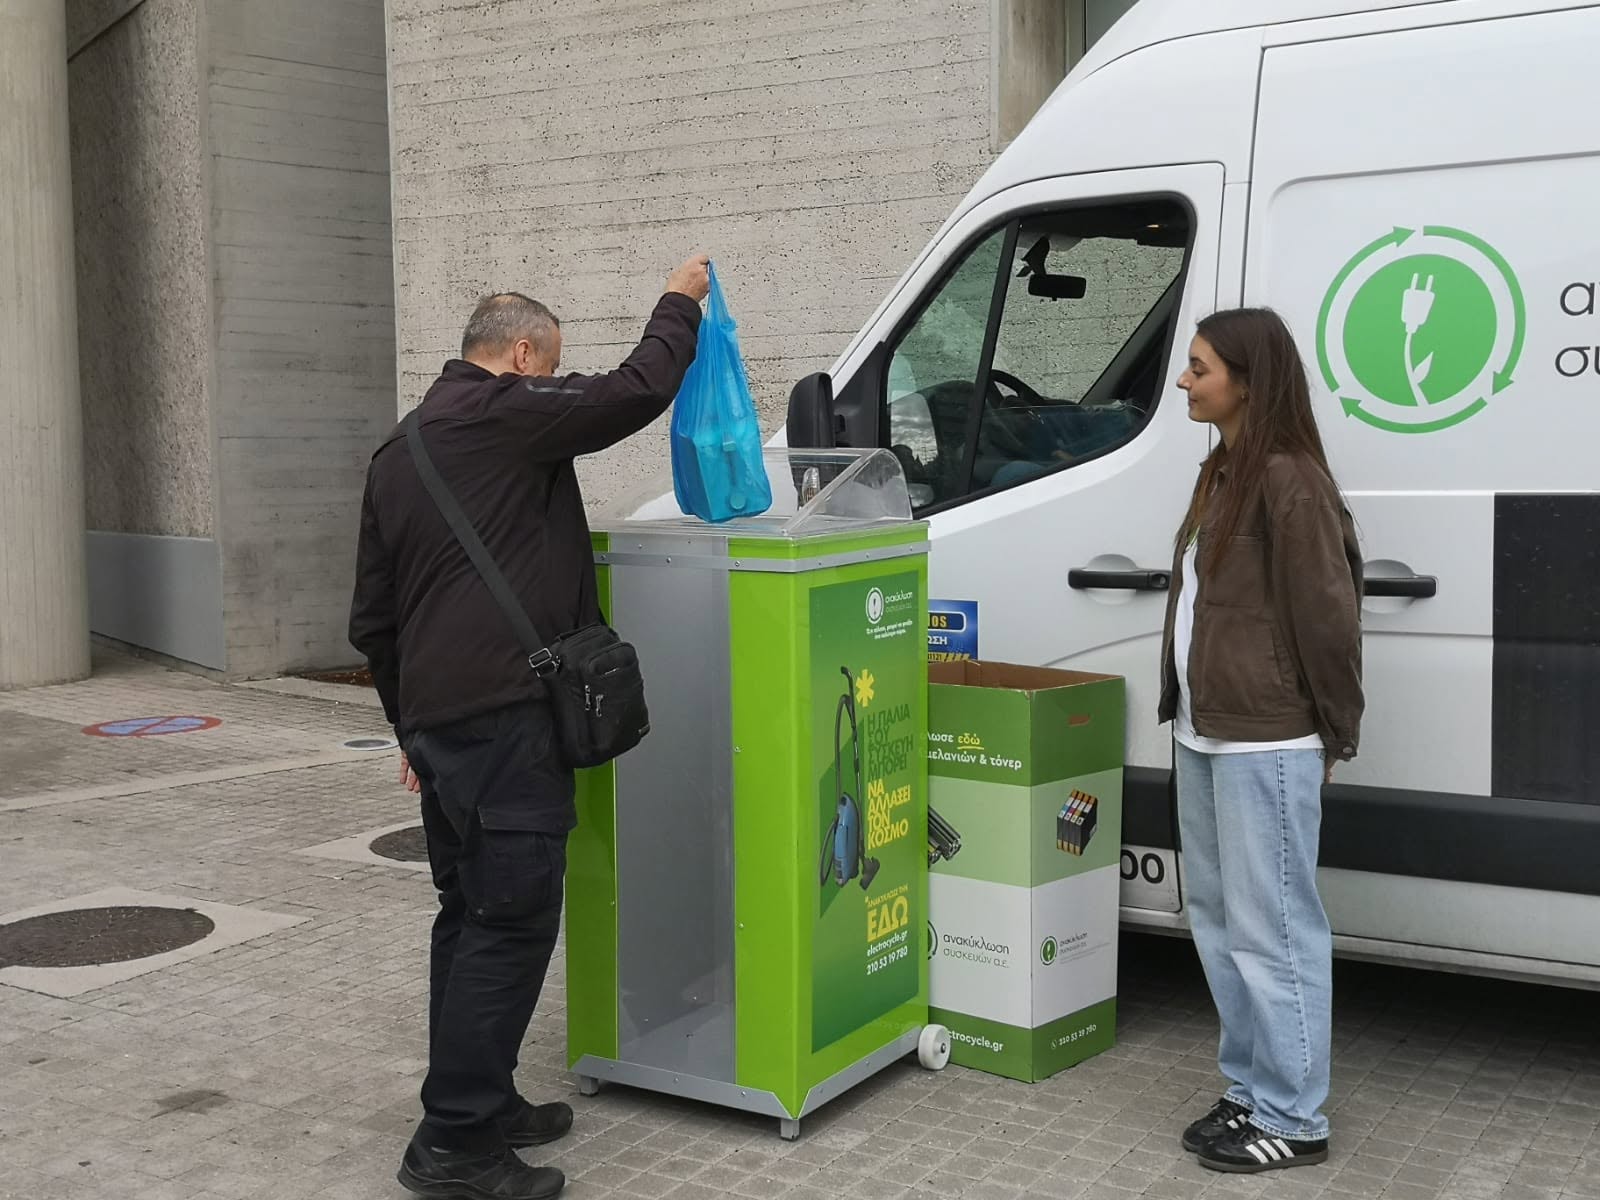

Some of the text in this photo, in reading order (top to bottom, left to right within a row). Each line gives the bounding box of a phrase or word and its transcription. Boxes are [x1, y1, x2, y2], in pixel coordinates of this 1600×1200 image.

[928, 613, 948, 628] OS
[879, 703, 911, 730] ΠΑΛΙΑ
[868, 734, 914, 769] ΣΥΣΚΕΥΗ
[958, 732, 981, 745] εδώ
[868, 752, 907, 783] ΜΠΟΡΕΙ
[980, 754, 988, 765] &
[990, 754, 1022, 771] τόνερ
[868, 779, 884, 800] ΝΑ
[868, 784, 911, 818] ΑΛΛΑΞΕΙ
[868, 807, 890, 833] ΤΟΝ
[868, 818, 909, 850] ΚΟΣΜΟ
[867, 895, 909, 942] ΕΔΩ
[867, 931, 908, 956] electrocycle.gr
[943, 934, 1010, 955] ανακύκλωση
[943, 948, 992, 964] συσκευών
[867, 945, 908, 975] 210 53 19 780
